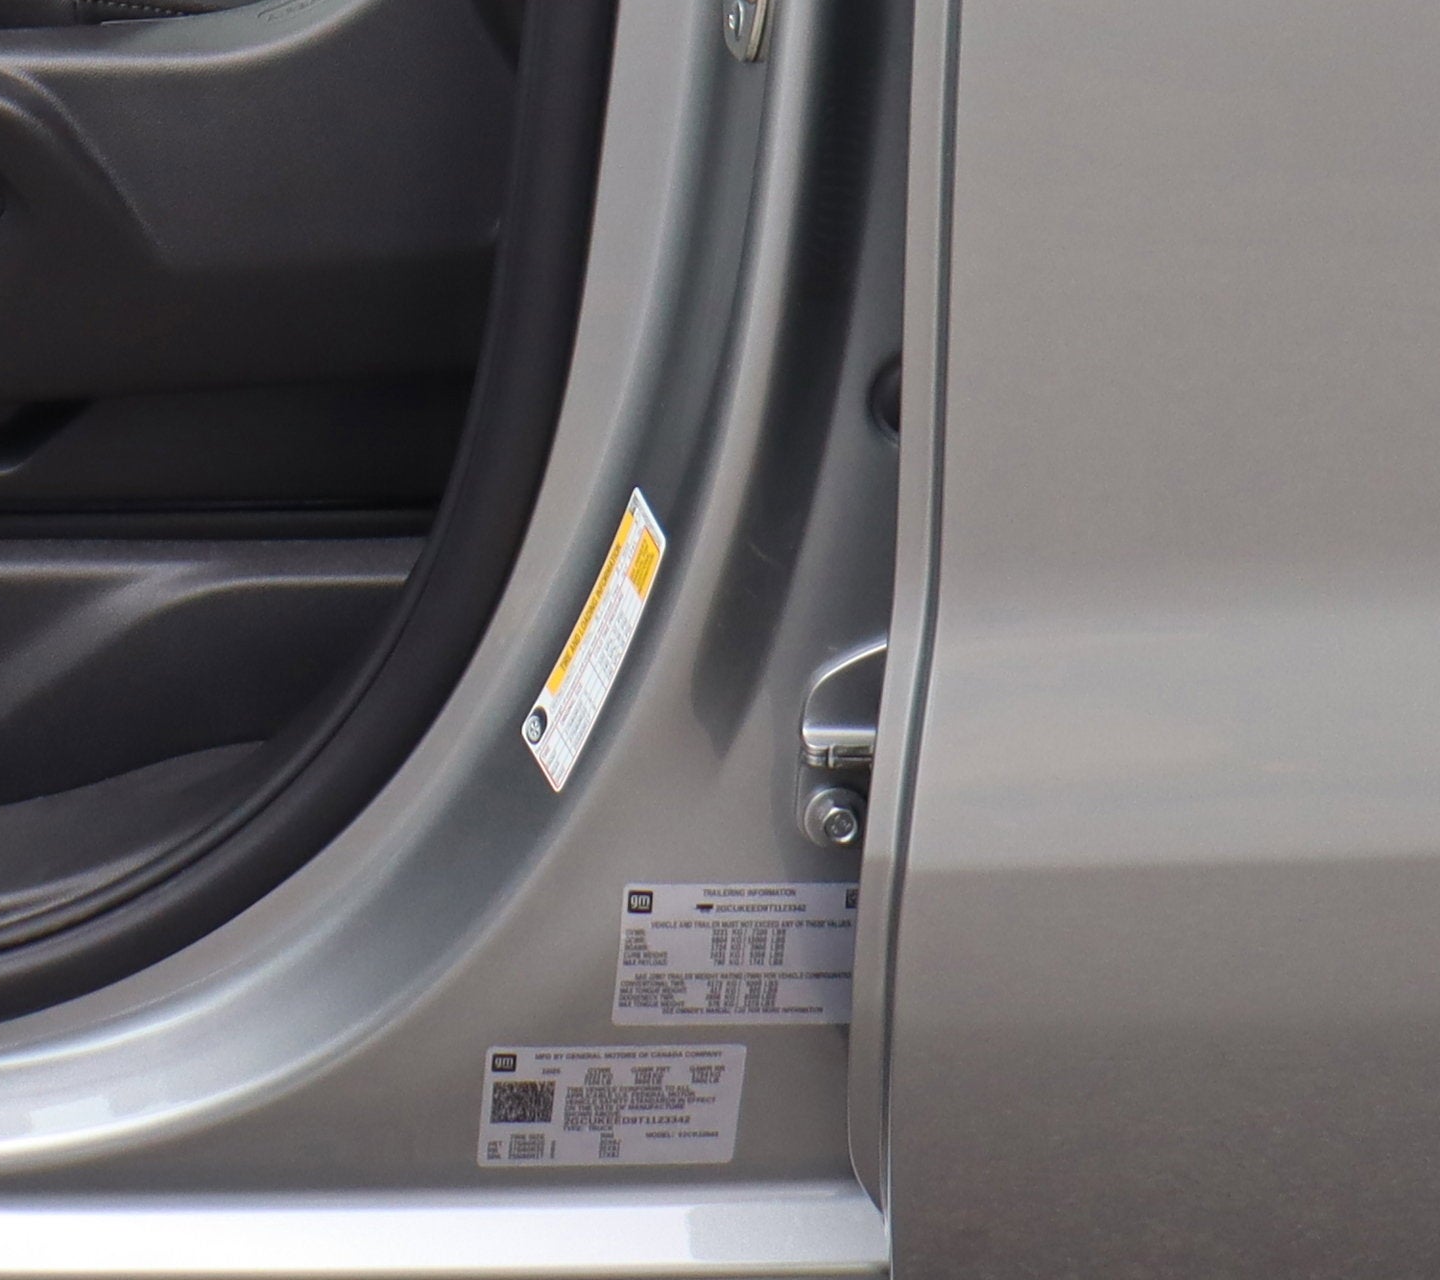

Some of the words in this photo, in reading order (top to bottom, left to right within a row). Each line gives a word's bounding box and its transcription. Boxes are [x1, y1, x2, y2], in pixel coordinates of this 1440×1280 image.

[578, 597, 599, 639] LOADING
[594, 544, 622, 602] INFORMATION
[703, 889, 745, 897] TRAILERING
[747, 889, 796, 897] INFORMATION
[630, 894, 651, 910] gm
[651, 921, 677, 929] VEHICLE
[679, 921, 692, 929] AND
[695, 921, 720, 929] TRAILER
[722, 921, 738, 929] MUST
[494, 1057, 514, 1069] gm
[564, 1116, 690, 1125] 2GCUKEED9T1123342
